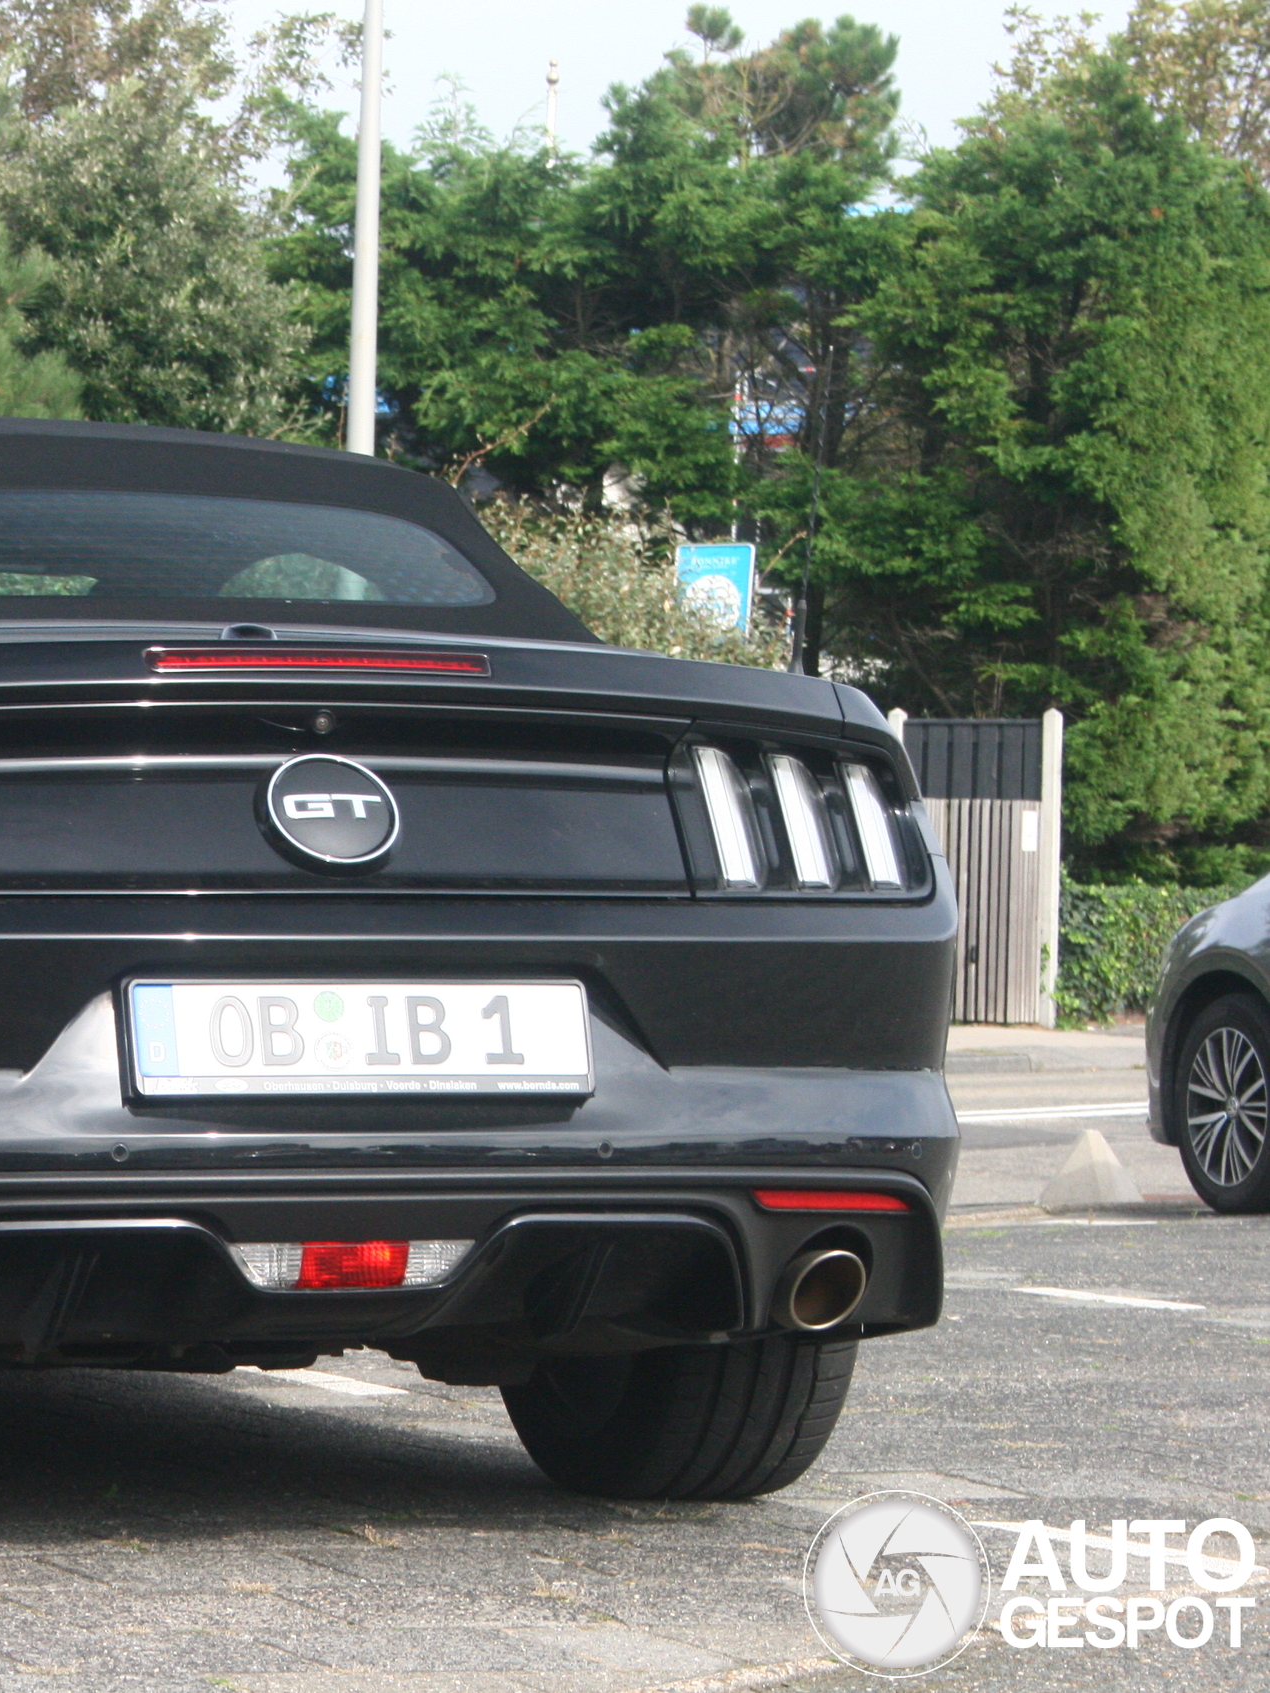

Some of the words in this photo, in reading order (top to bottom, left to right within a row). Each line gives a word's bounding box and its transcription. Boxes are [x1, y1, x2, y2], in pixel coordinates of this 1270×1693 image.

[283, 793, 381, 819] GT
[209, 995, 305, 1067] OB
[365, 995, 452, 1066] IB
[480, 995, 525, 1065] 1
[148, 1041, 165, 1062] D
[263, 1080, 325, 1092] Oberhausen
[332, 1080, 378, 1093] Duisburg
[385, 1080, 421, 1091] Voerde
[429, 1079, 477, 1091] Dinslaken
[497, 1080, 580, 1091] www.bernds.com
